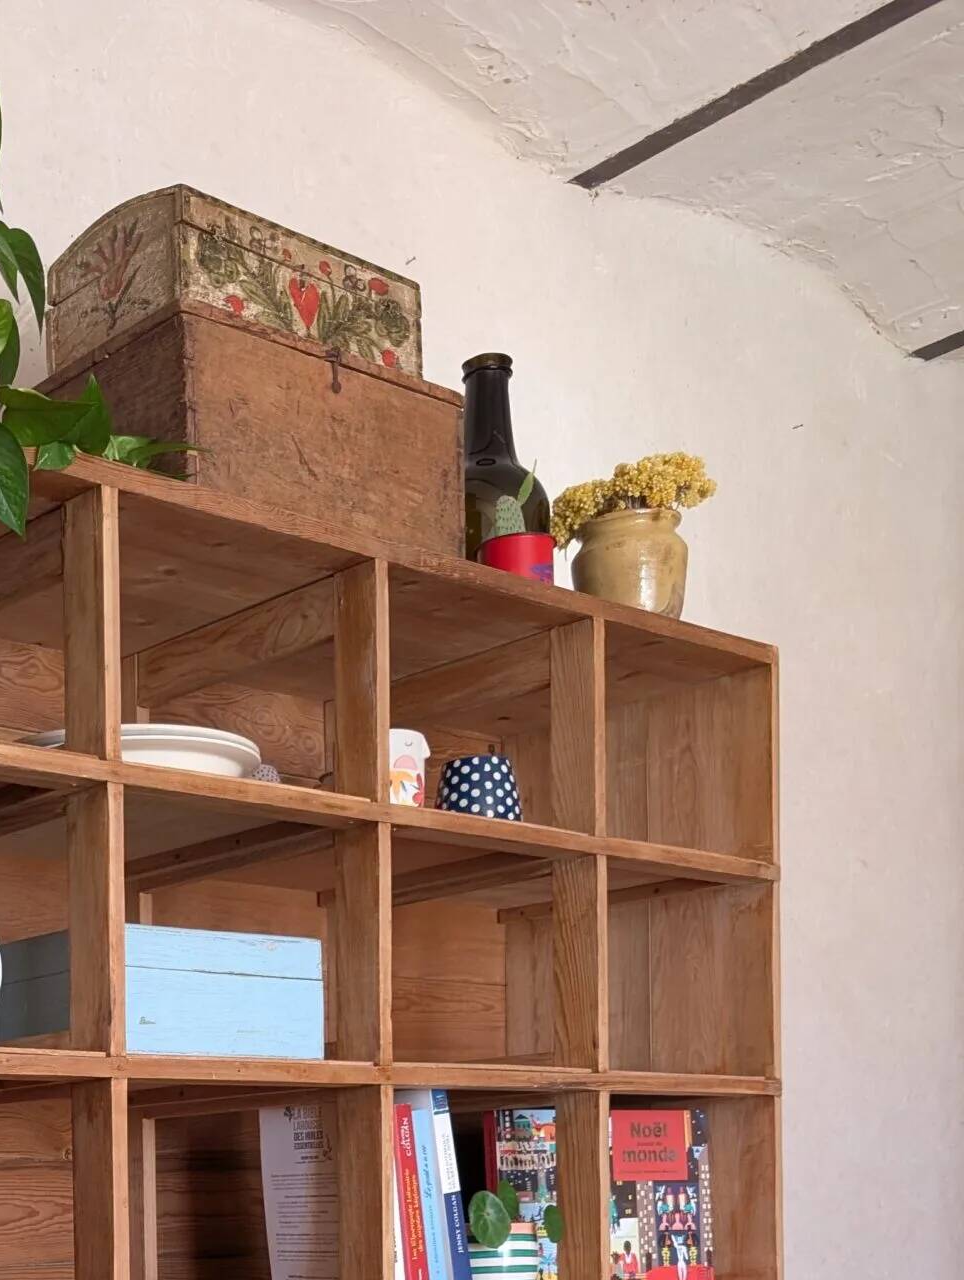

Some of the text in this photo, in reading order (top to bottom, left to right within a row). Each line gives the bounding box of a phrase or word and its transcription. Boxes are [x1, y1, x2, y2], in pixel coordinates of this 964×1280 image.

[402, 1117, 412, 1156] COLGAN
[630, 1121, 667, 1138] Noël
[622, 1147, 677, 1163] monde
[449, 1195, 464, 1253] JENNY COLGAN
